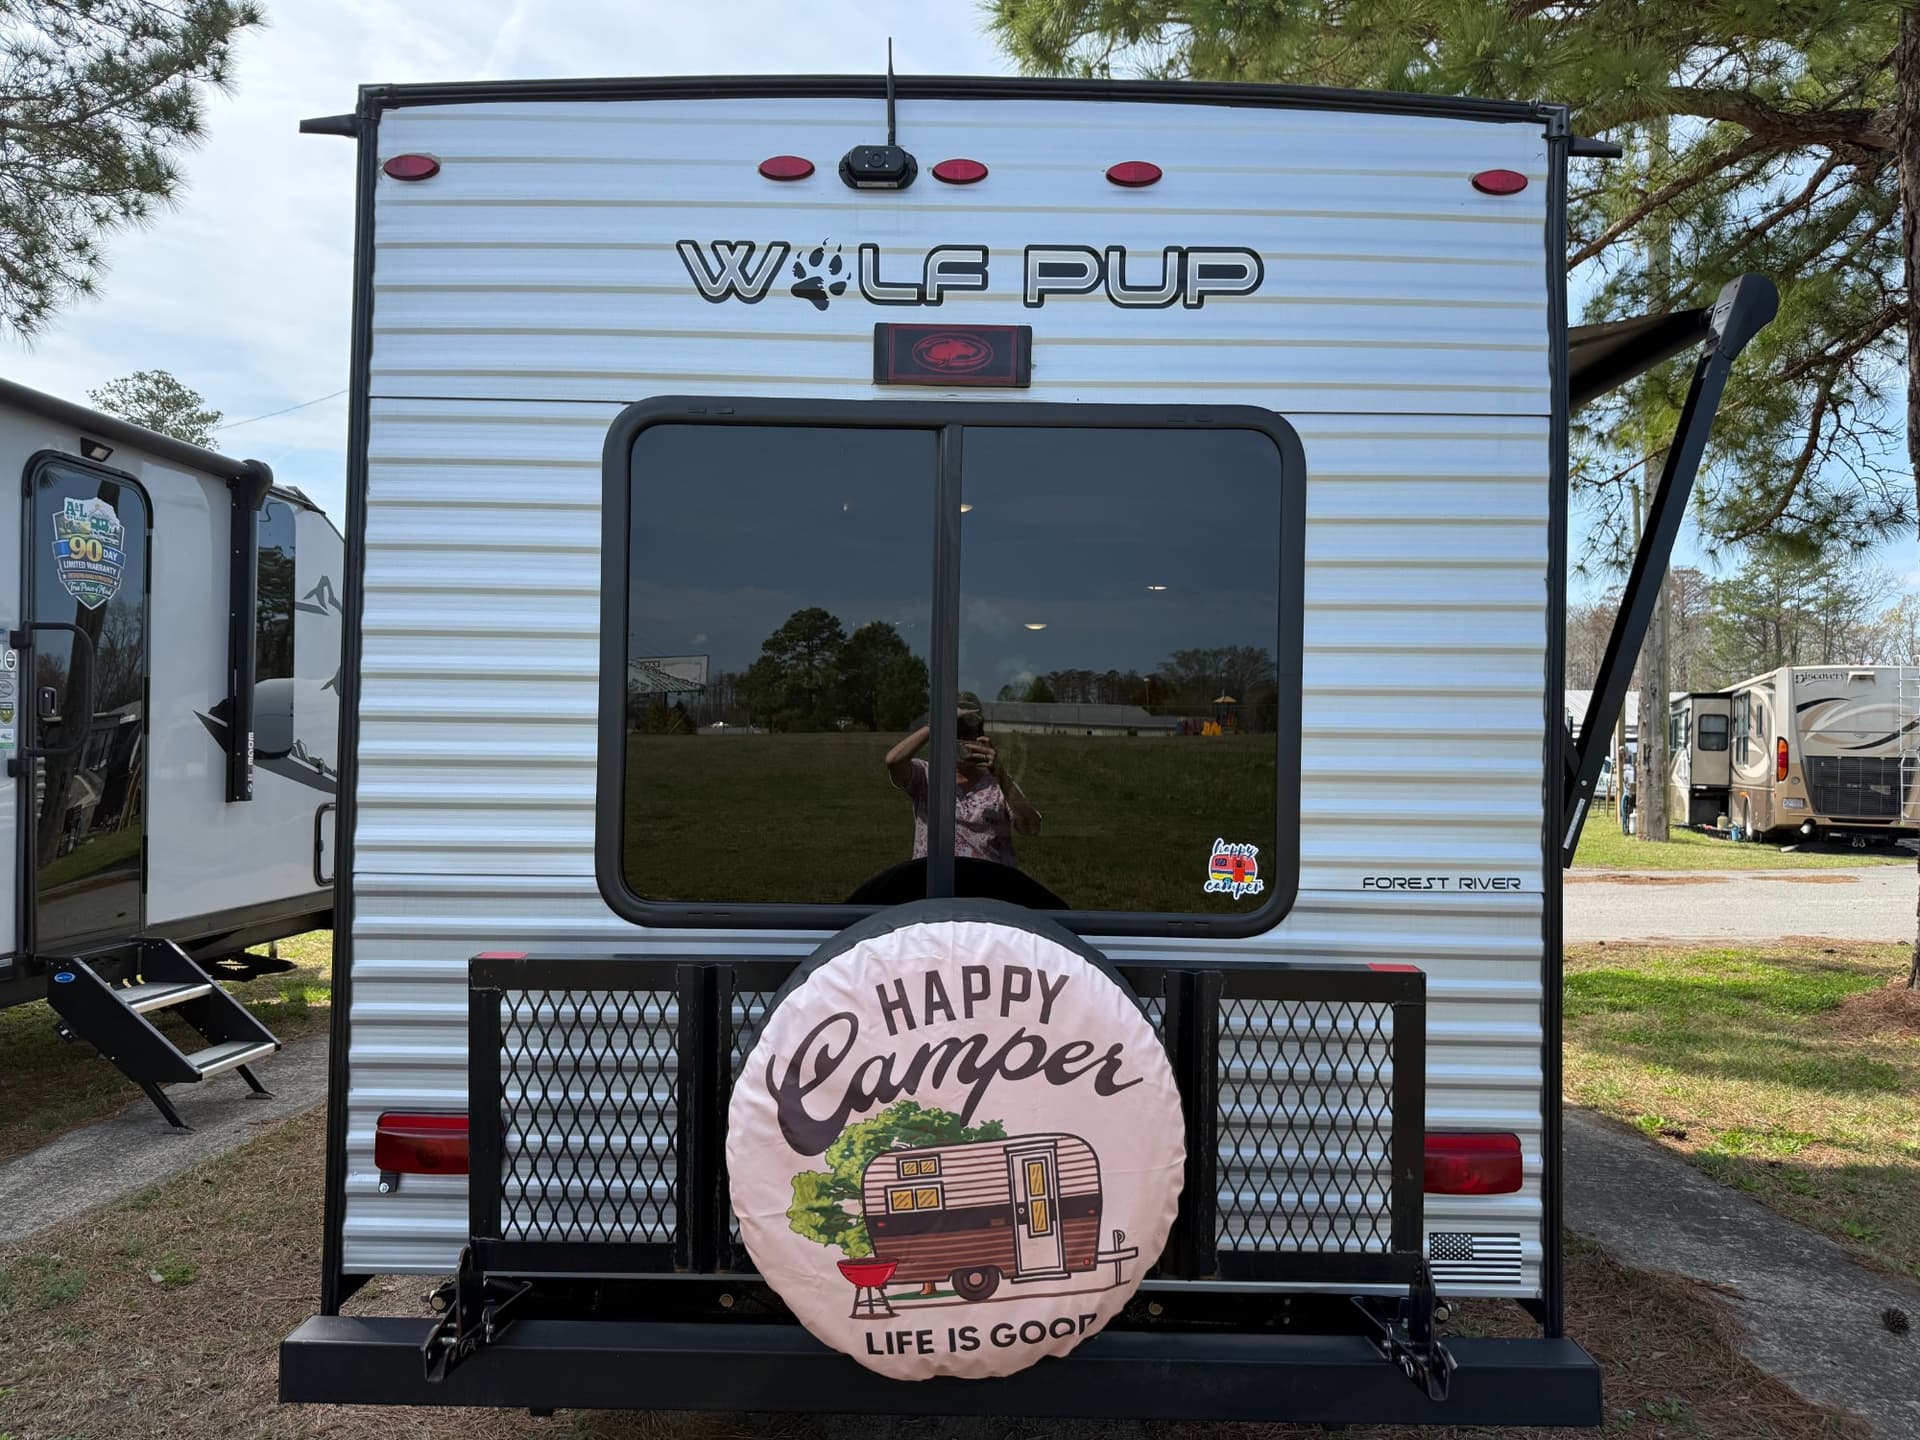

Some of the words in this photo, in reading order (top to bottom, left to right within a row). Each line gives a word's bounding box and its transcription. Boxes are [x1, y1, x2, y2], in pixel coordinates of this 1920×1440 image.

[1023, 244, 1265, 309] PUP
[69, 536, 103, 562] 90
[103, 549, 118, 560] DAY
[63, 560, 86, 569] LIMITED
[87, 561, 117, 575] WARRANTY
[1213, 838, 1258, 859] happy
[1204, 880, 1263, 899] camper
[1362, 877, 1450, 889] FOREST
[1459, 877, 1521, 890] RIVER
[875, 964, 1070, 1037] HAPPY
[765, 1011, 1143, 1157] Camper
[866, 1329, 935, 1355] LIFE
[948, 1326, 981, 1353] IS
